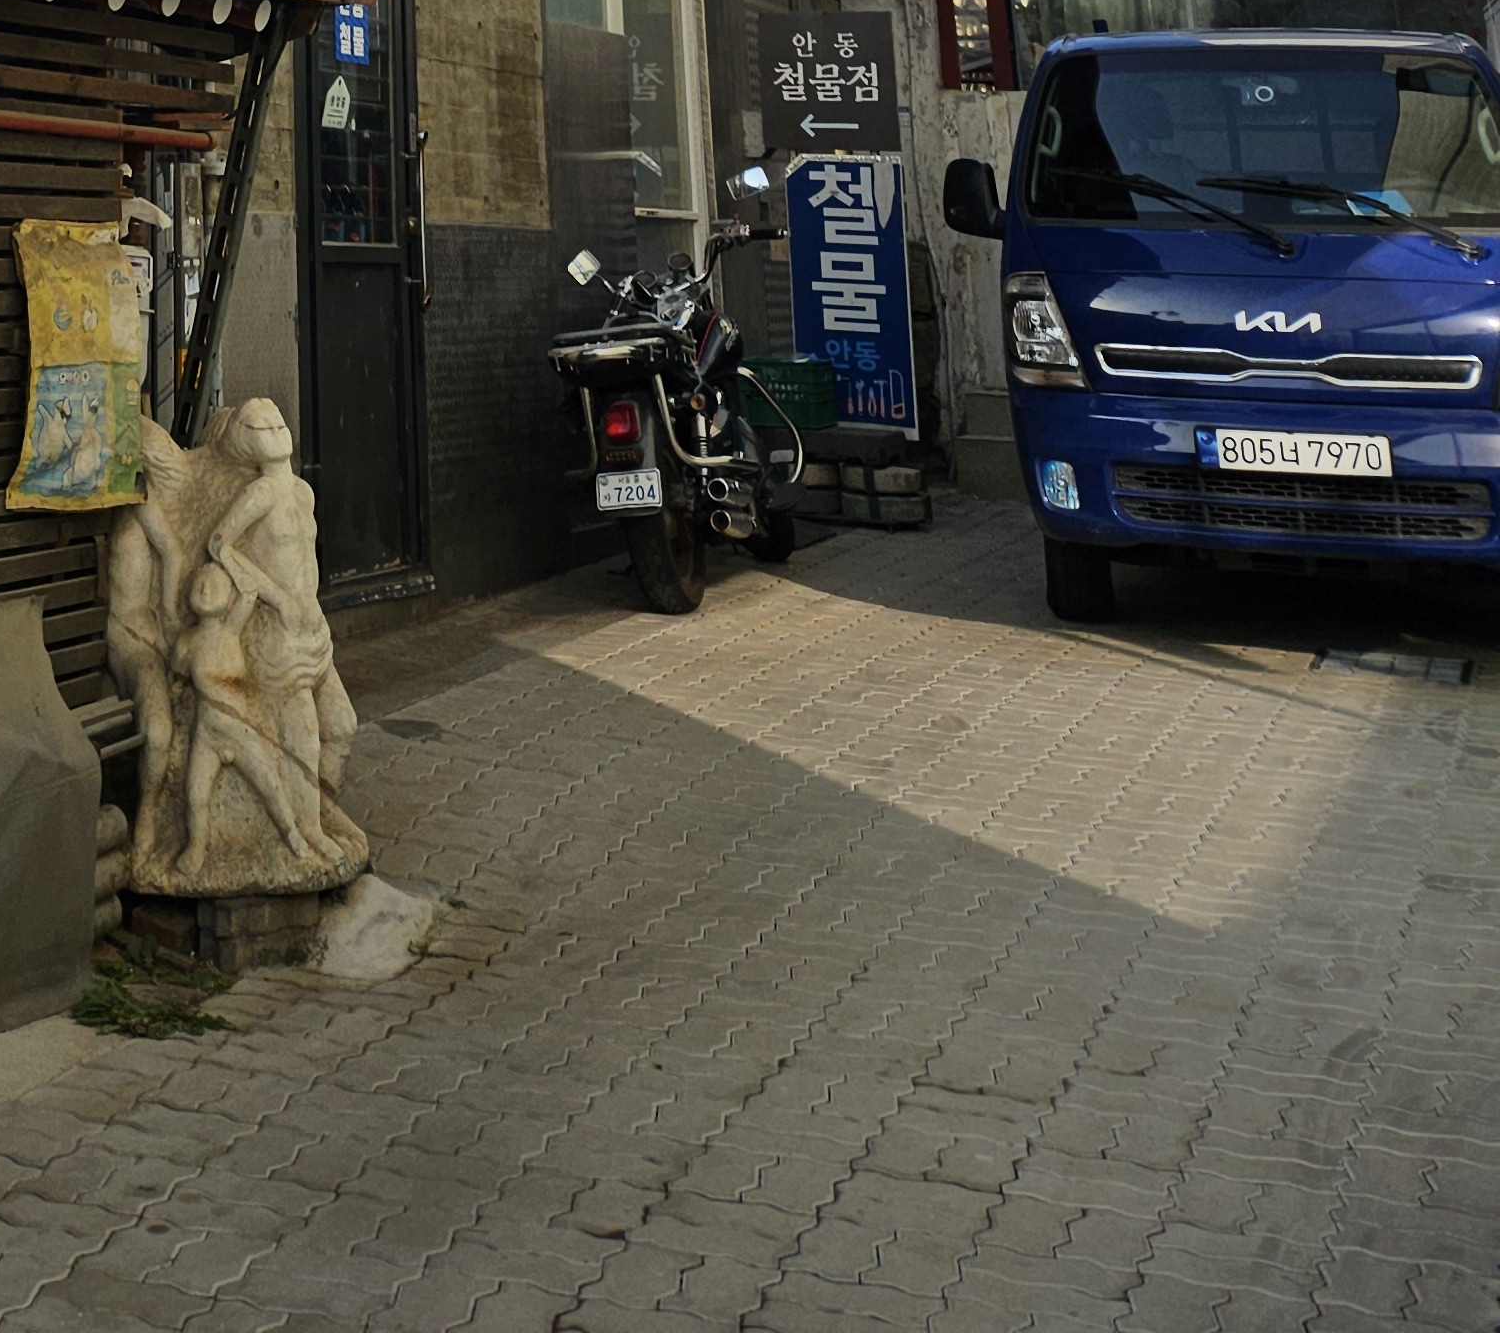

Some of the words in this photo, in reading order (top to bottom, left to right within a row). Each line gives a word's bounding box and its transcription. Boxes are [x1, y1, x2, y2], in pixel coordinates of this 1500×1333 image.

[340, 22, 364, 57] 철물
[773, 62, 880, 103] 철물점
[808, 164, 887, 334] 철물
[1235, 310, 1321, 334] KIA
[825, 340, 880, 372] 안동
[1221, 435, 1301, 467] 805너
[1307, 440, 1384, 471] 7970
[613, 484, 656, 503] 7204
